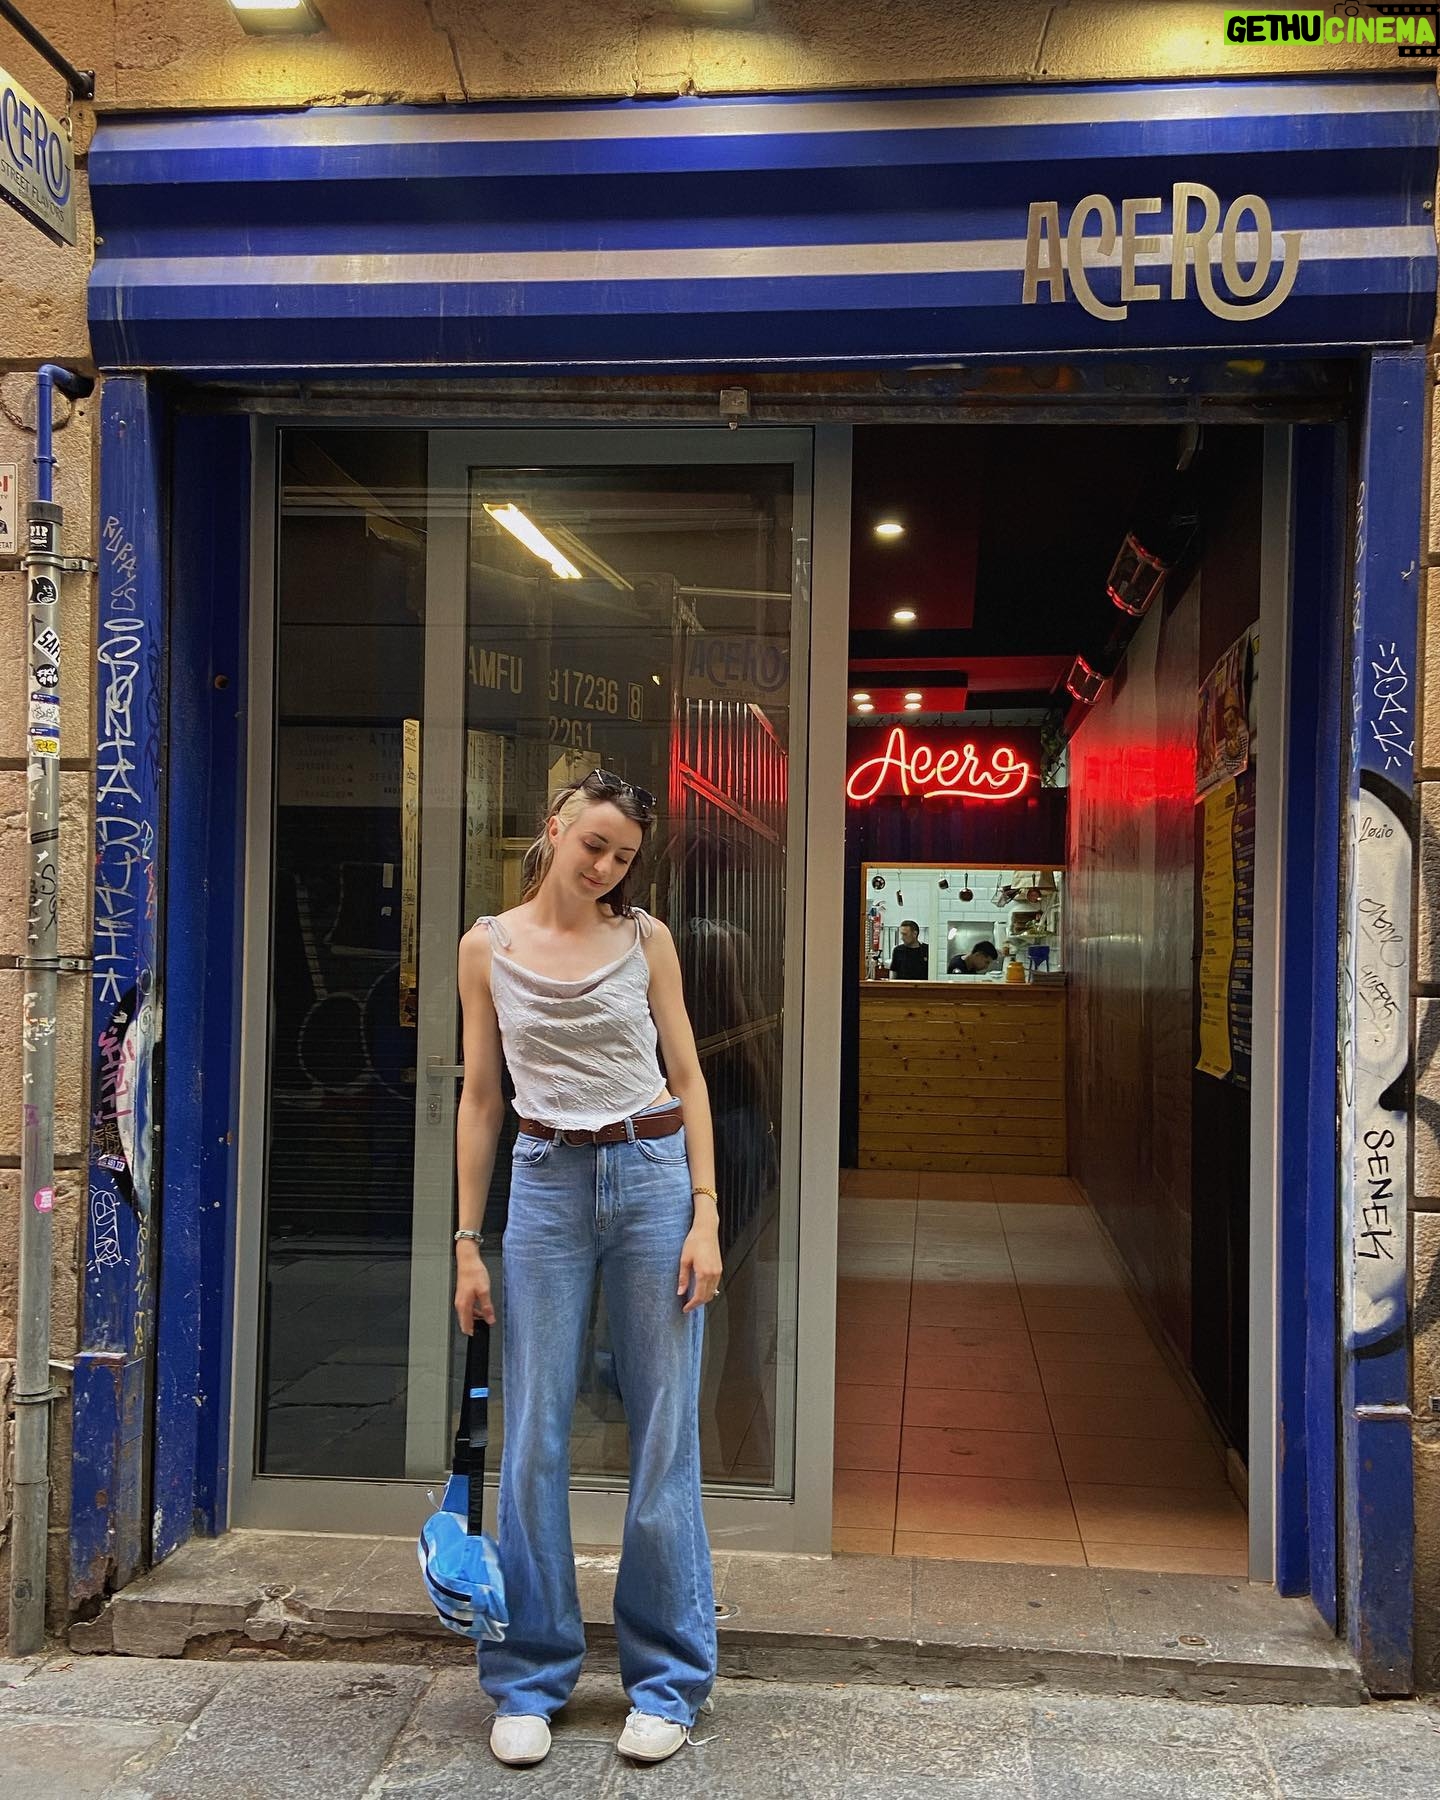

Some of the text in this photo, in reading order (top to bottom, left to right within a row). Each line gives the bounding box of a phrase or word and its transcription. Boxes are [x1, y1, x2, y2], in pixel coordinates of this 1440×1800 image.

[0, 87, 71, 207] CERO
[1, 158, 31, 190] STREET
[1022, 182, 1302, 321] ACERO
[689, 639, 790, 692] ACERO
[847, 727, 1029, 800] Acero
